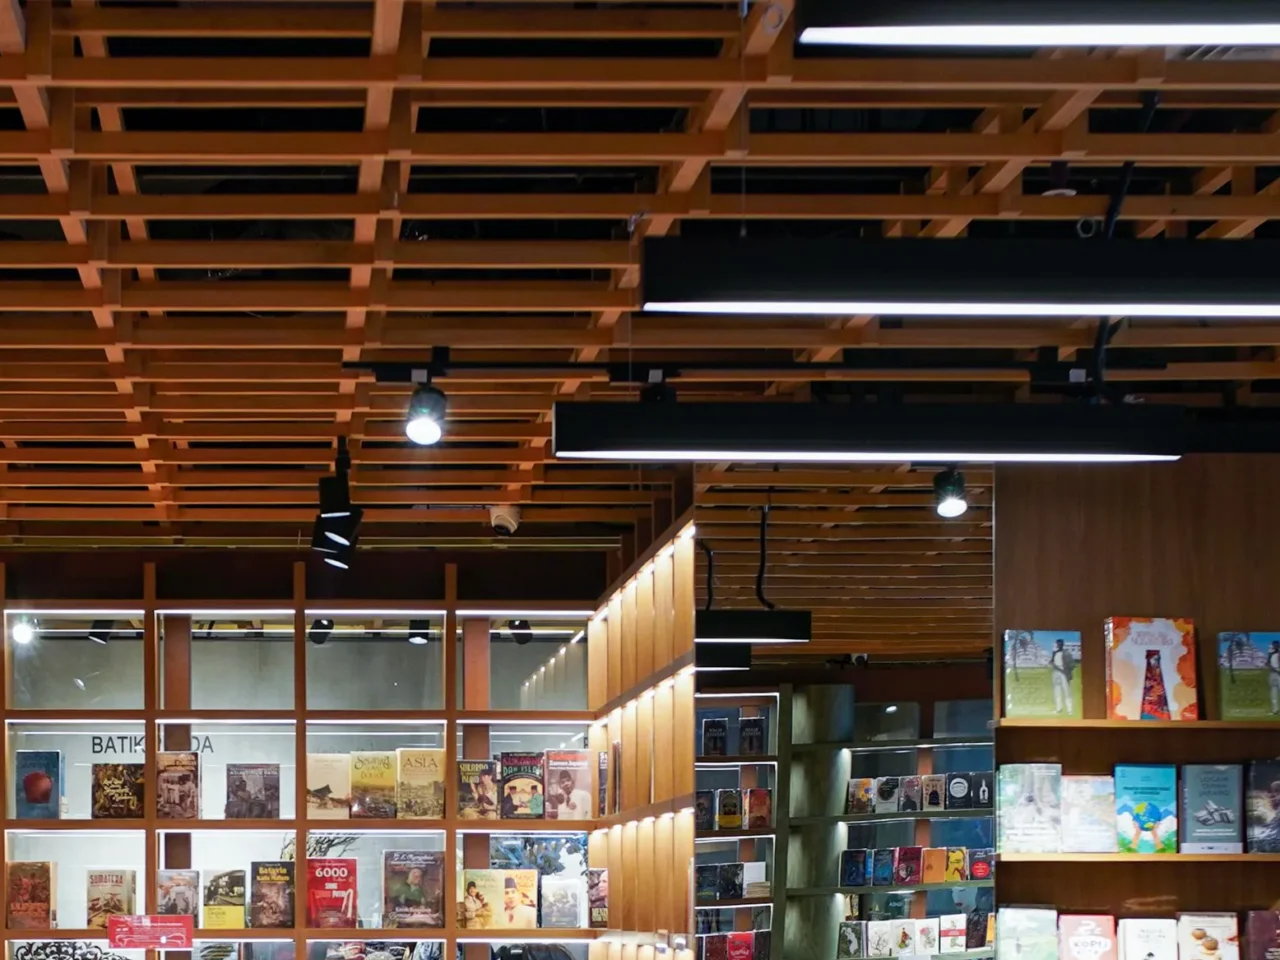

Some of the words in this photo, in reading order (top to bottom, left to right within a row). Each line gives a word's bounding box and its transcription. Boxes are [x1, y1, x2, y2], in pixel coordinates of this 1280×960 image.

[92, 736, 146, 754] BATIK
[403, 757, 438, 768] ASIA
[315, 867, 348, 877] 6000
